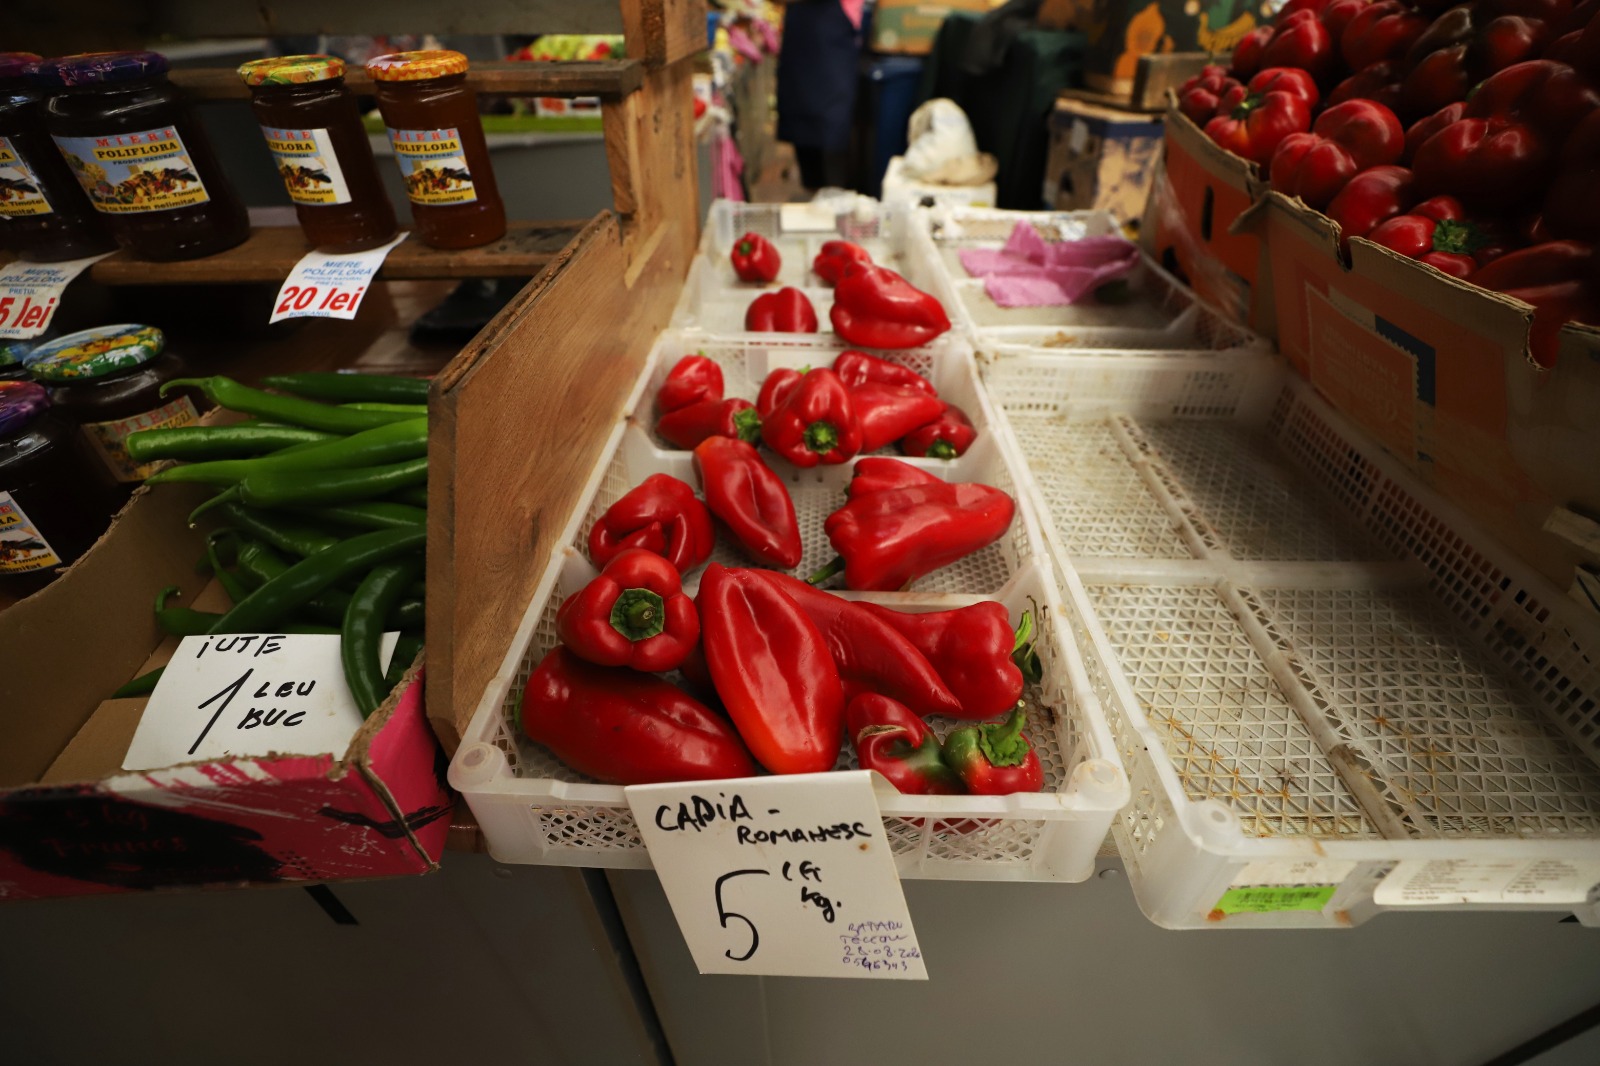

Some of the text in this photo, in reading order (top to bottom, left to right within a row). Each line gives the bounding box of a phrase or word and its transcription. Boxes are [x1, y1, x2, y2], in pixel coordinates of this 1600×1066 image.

[95, 129, 174, 147] MIERE
[96, 142, 178, 159] POLIFLORA
[394, 142, 457, 152] POLIFLORA
[144, 153, 177, 163] NATURAL
[173, 187, 203, 198] Timotei
[153, 197, 197, 210] nelimitat
[302, 267, 372, 276] POLIFLORA
[323, 260, 363, 268] MIERE
[276, 286, 365, 314] 20 lei
[11, 296, 56, 328] lei
[14, 552, 52, 565] Timotei
[187, 667, 316, 755] 1 LEU
[236, 707, 307, 730] BUC
[714, 869, 771, 962] 5
